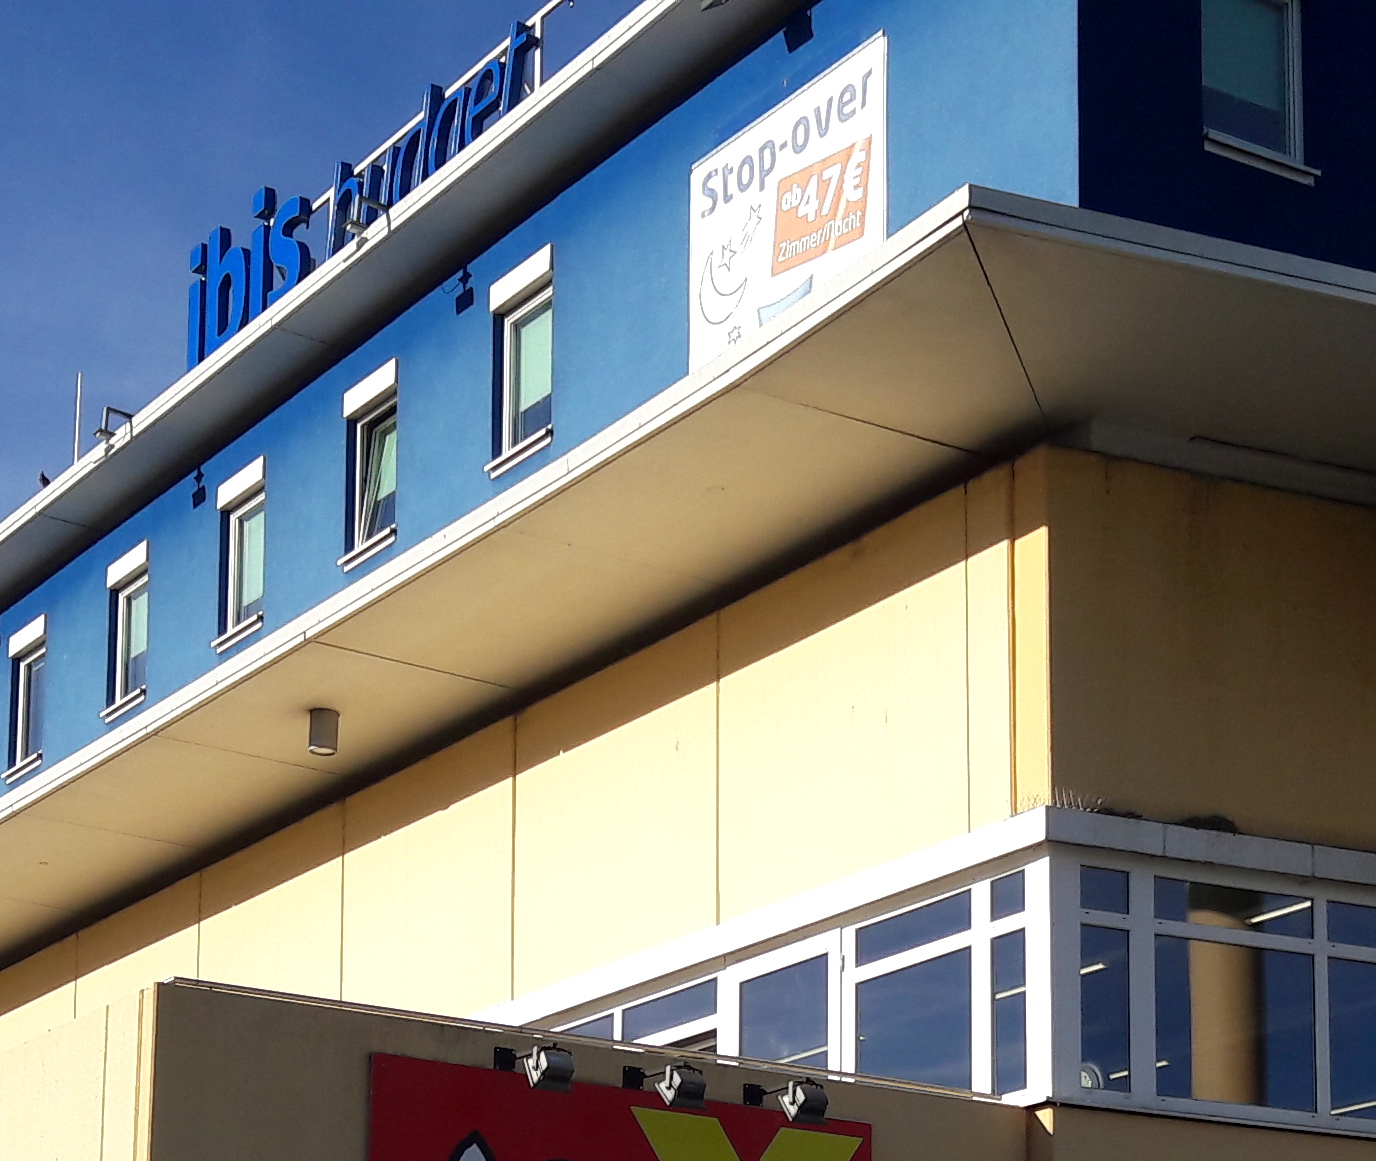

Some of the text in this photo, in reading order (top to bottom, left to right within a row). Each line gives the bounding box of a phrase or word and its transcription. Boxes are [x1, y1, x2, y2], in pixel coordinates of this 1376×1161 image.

[701, 67, 873, 219] Stop-over
[777, 209, 862, 263] Zimmer/Nacht
[781, 183, 803, 212] ab
[187, 186, 312, 371] ibis
